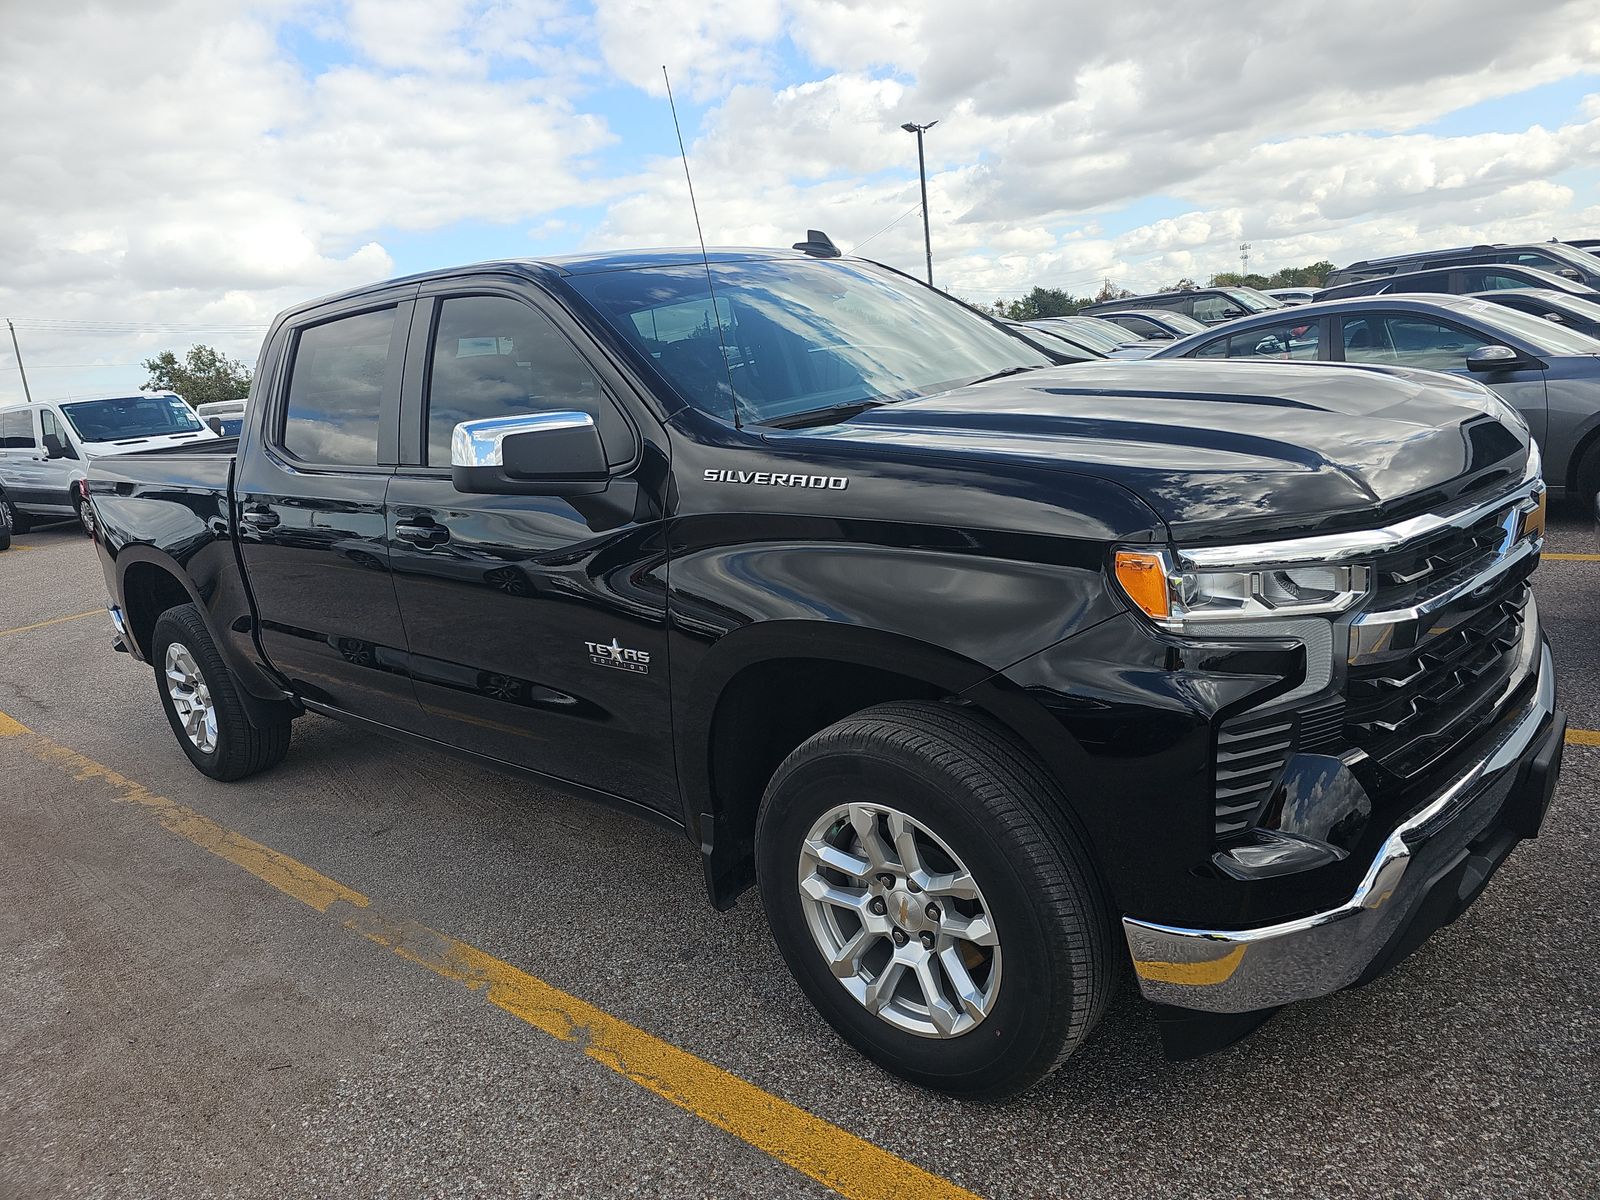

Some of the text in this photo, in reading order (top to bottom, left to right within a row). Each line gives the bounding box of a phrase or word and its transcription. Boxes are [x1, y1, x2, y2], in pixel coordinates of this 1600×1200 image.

[703, 469, 848, 490] SILVERADO
[584, 638, 650, 663] TEXAS
[593, 657, 645, 672] EDITION
